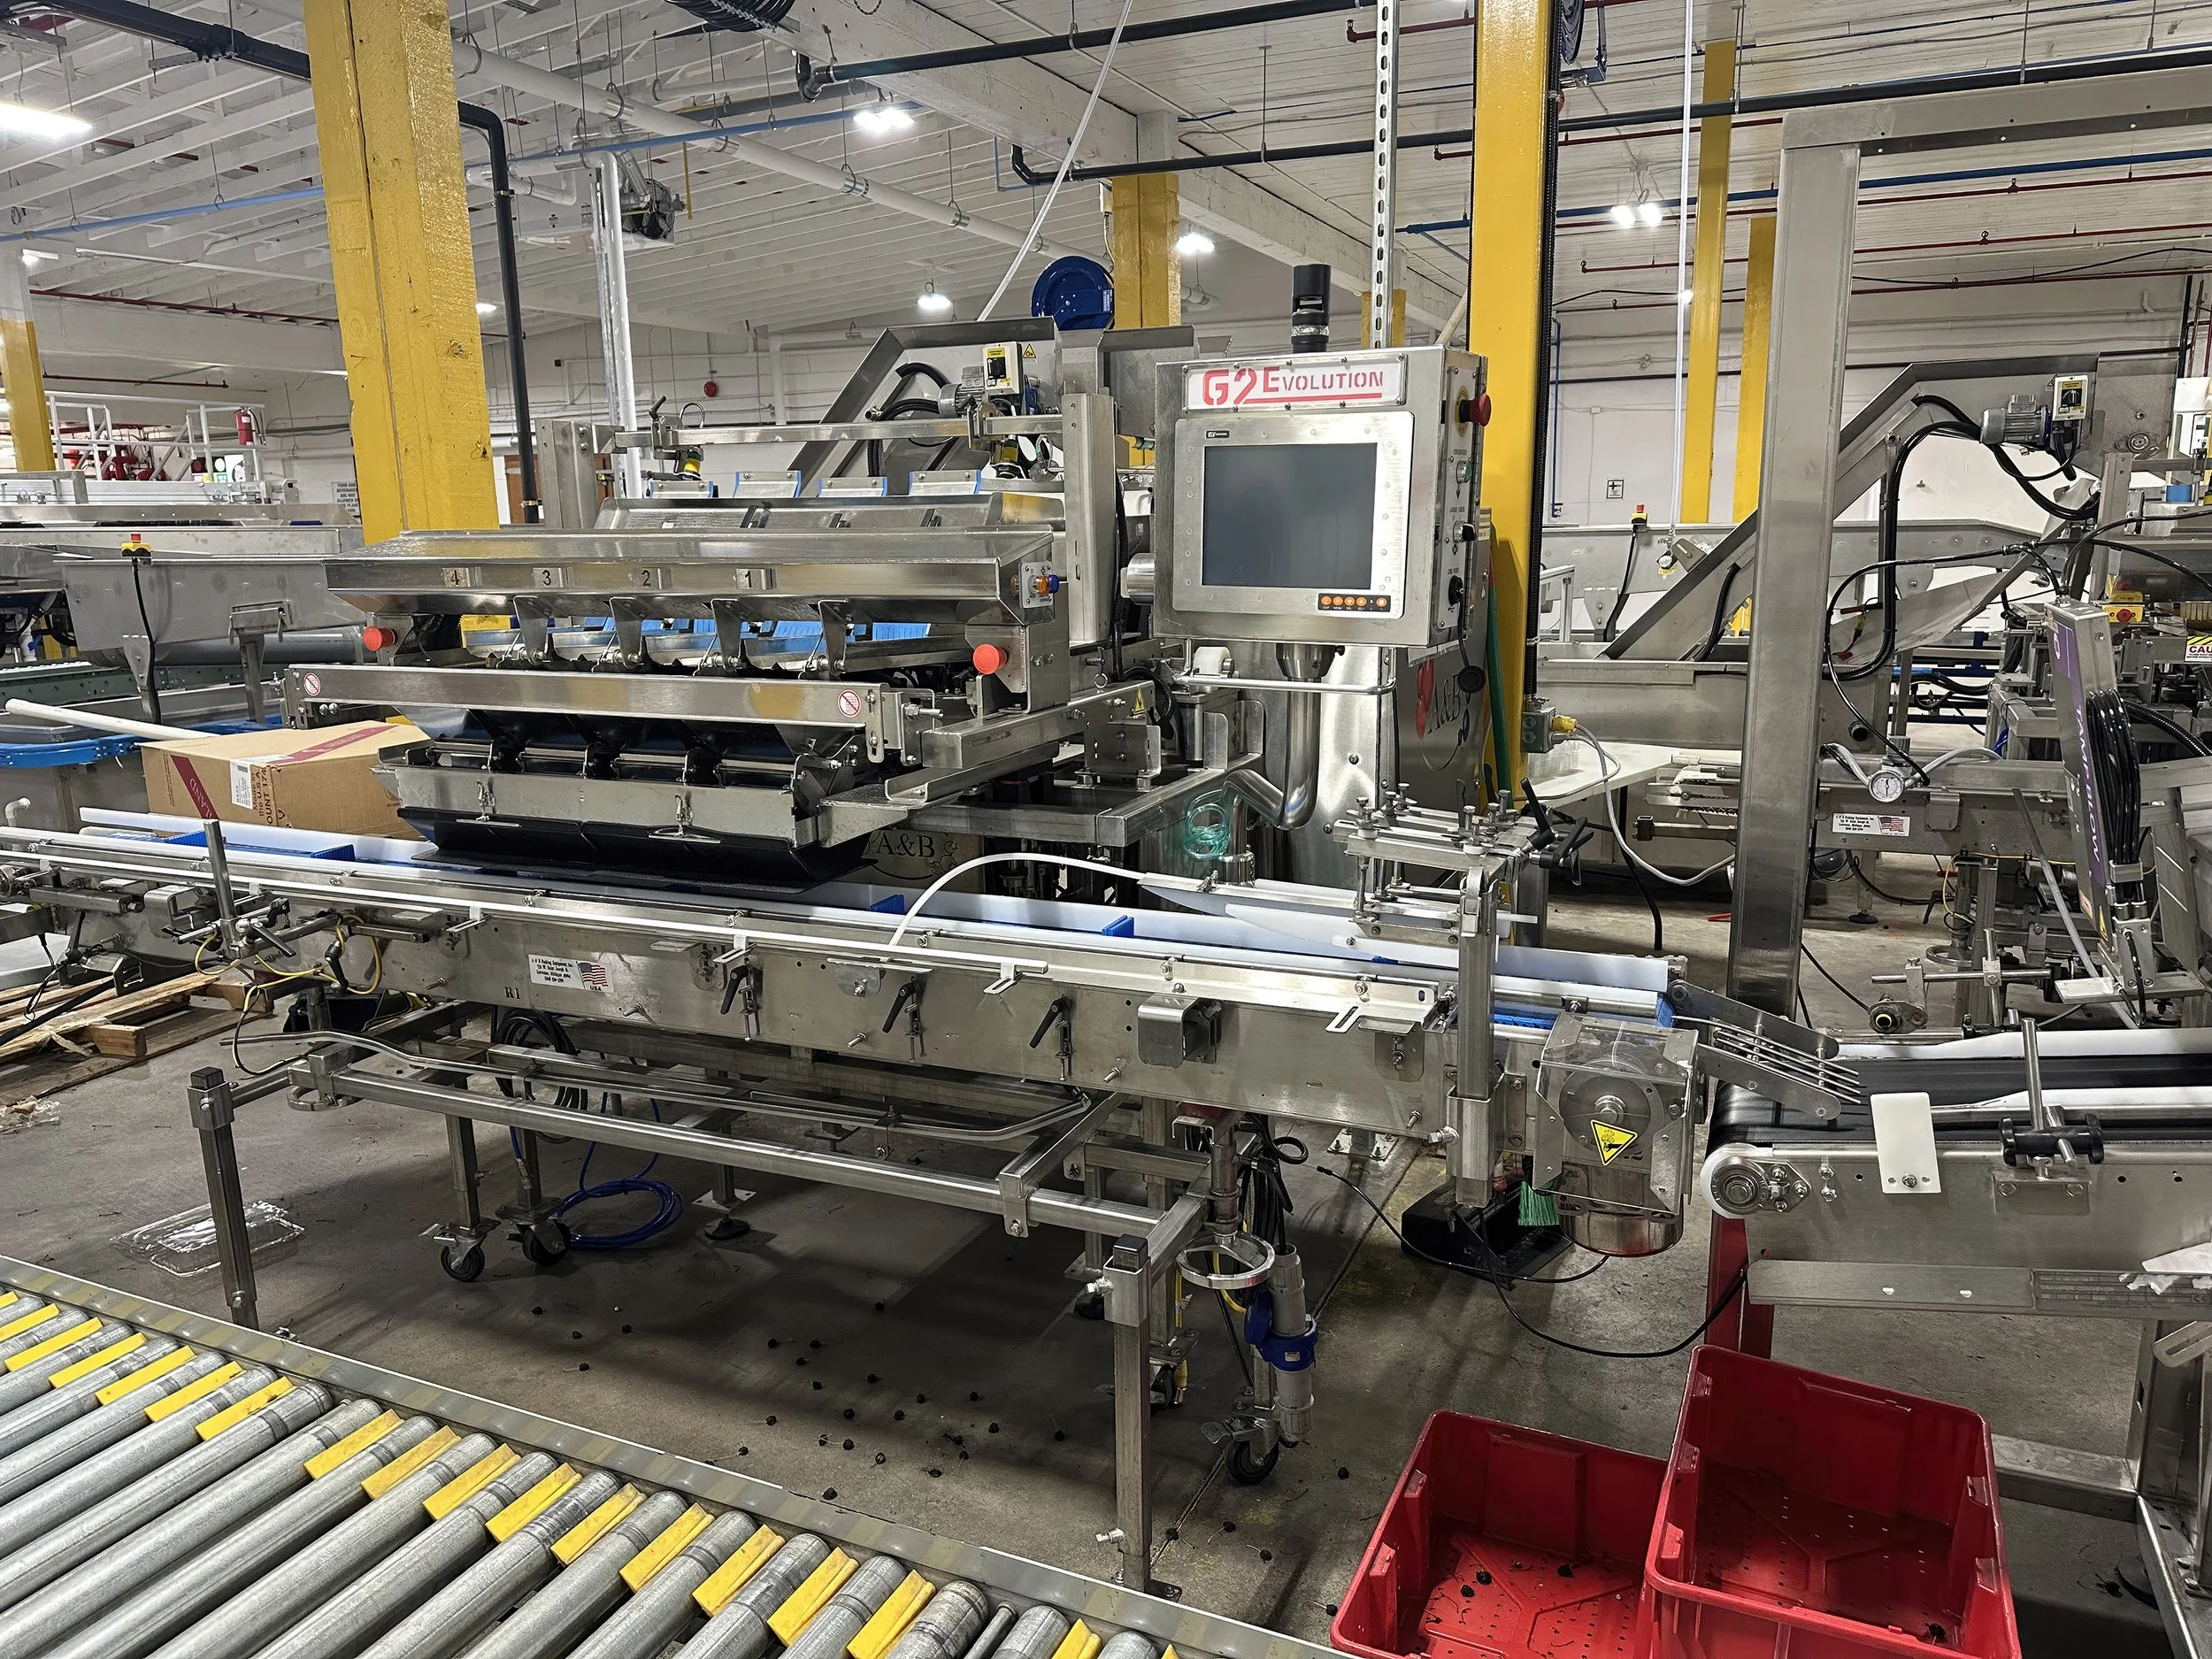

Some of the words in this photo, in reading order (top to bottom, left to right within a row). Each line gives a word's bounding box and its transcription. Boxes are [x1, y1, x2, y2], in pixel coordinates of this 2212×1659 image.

[450, 570, 459, 586] 4
[542, 570, 552, 586] 3
[641, 570, 651, 587] 2
[744, 572, 752, 588] 1
[2075, 705, 2090, 779] TAMP
[2085, 784, 2101, 863] BLOW
[263, 791, 273, 825] OUNT
[876, 832, 934, 857] A&B
